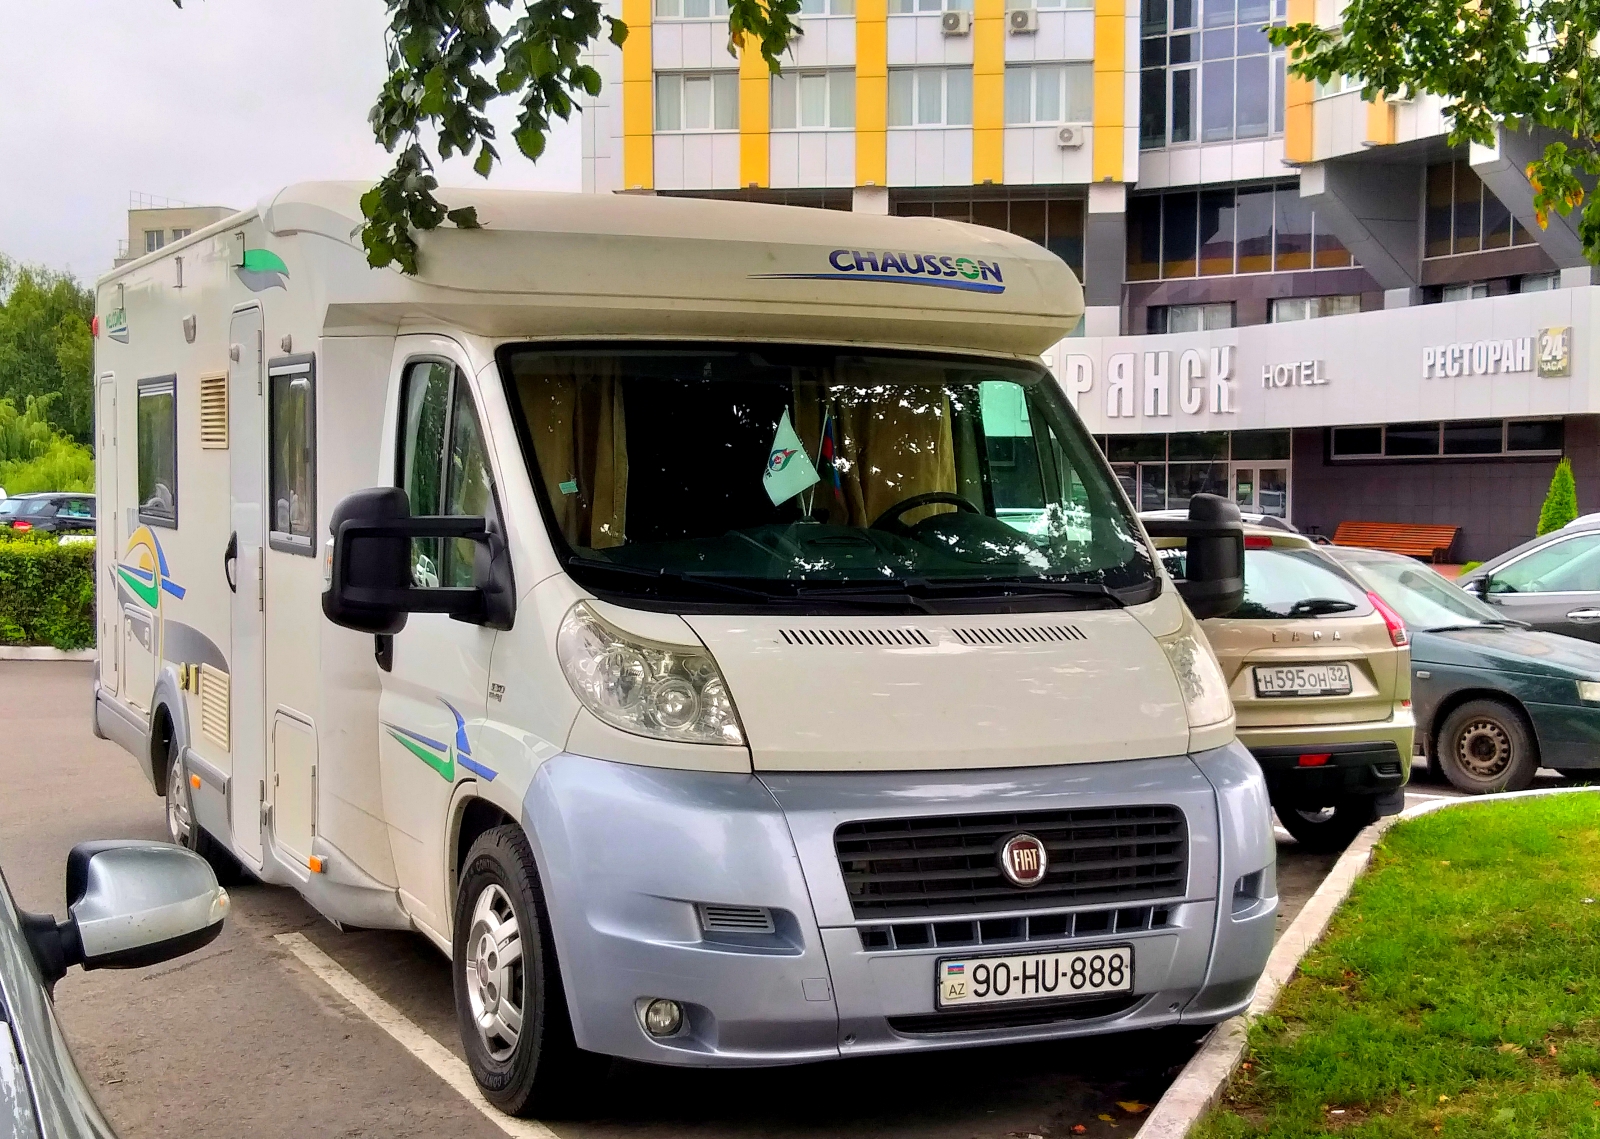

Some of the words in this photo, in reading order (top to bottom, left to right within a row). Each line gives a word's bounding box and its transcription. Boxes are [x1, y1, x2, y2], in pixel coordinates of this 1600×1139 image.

[829, 250, 1004, 282] CHAUSSON
[1422, 337, 1533, 379] РЕСТОРАН
[1541, 334, 1563, 361] 24
[1043, 345, 1235, 418] РЯНСК
[1261, 360, 1327, 388] HOTEL
[1271, 629, 1342, 643] LADA
[1329, 666, 1345, 682] 32
[1012, 848, 1038, 872] FIAT
[949, 982, 966, 997] AZ
[972, 953, 1124, 998] 90-HU-888
